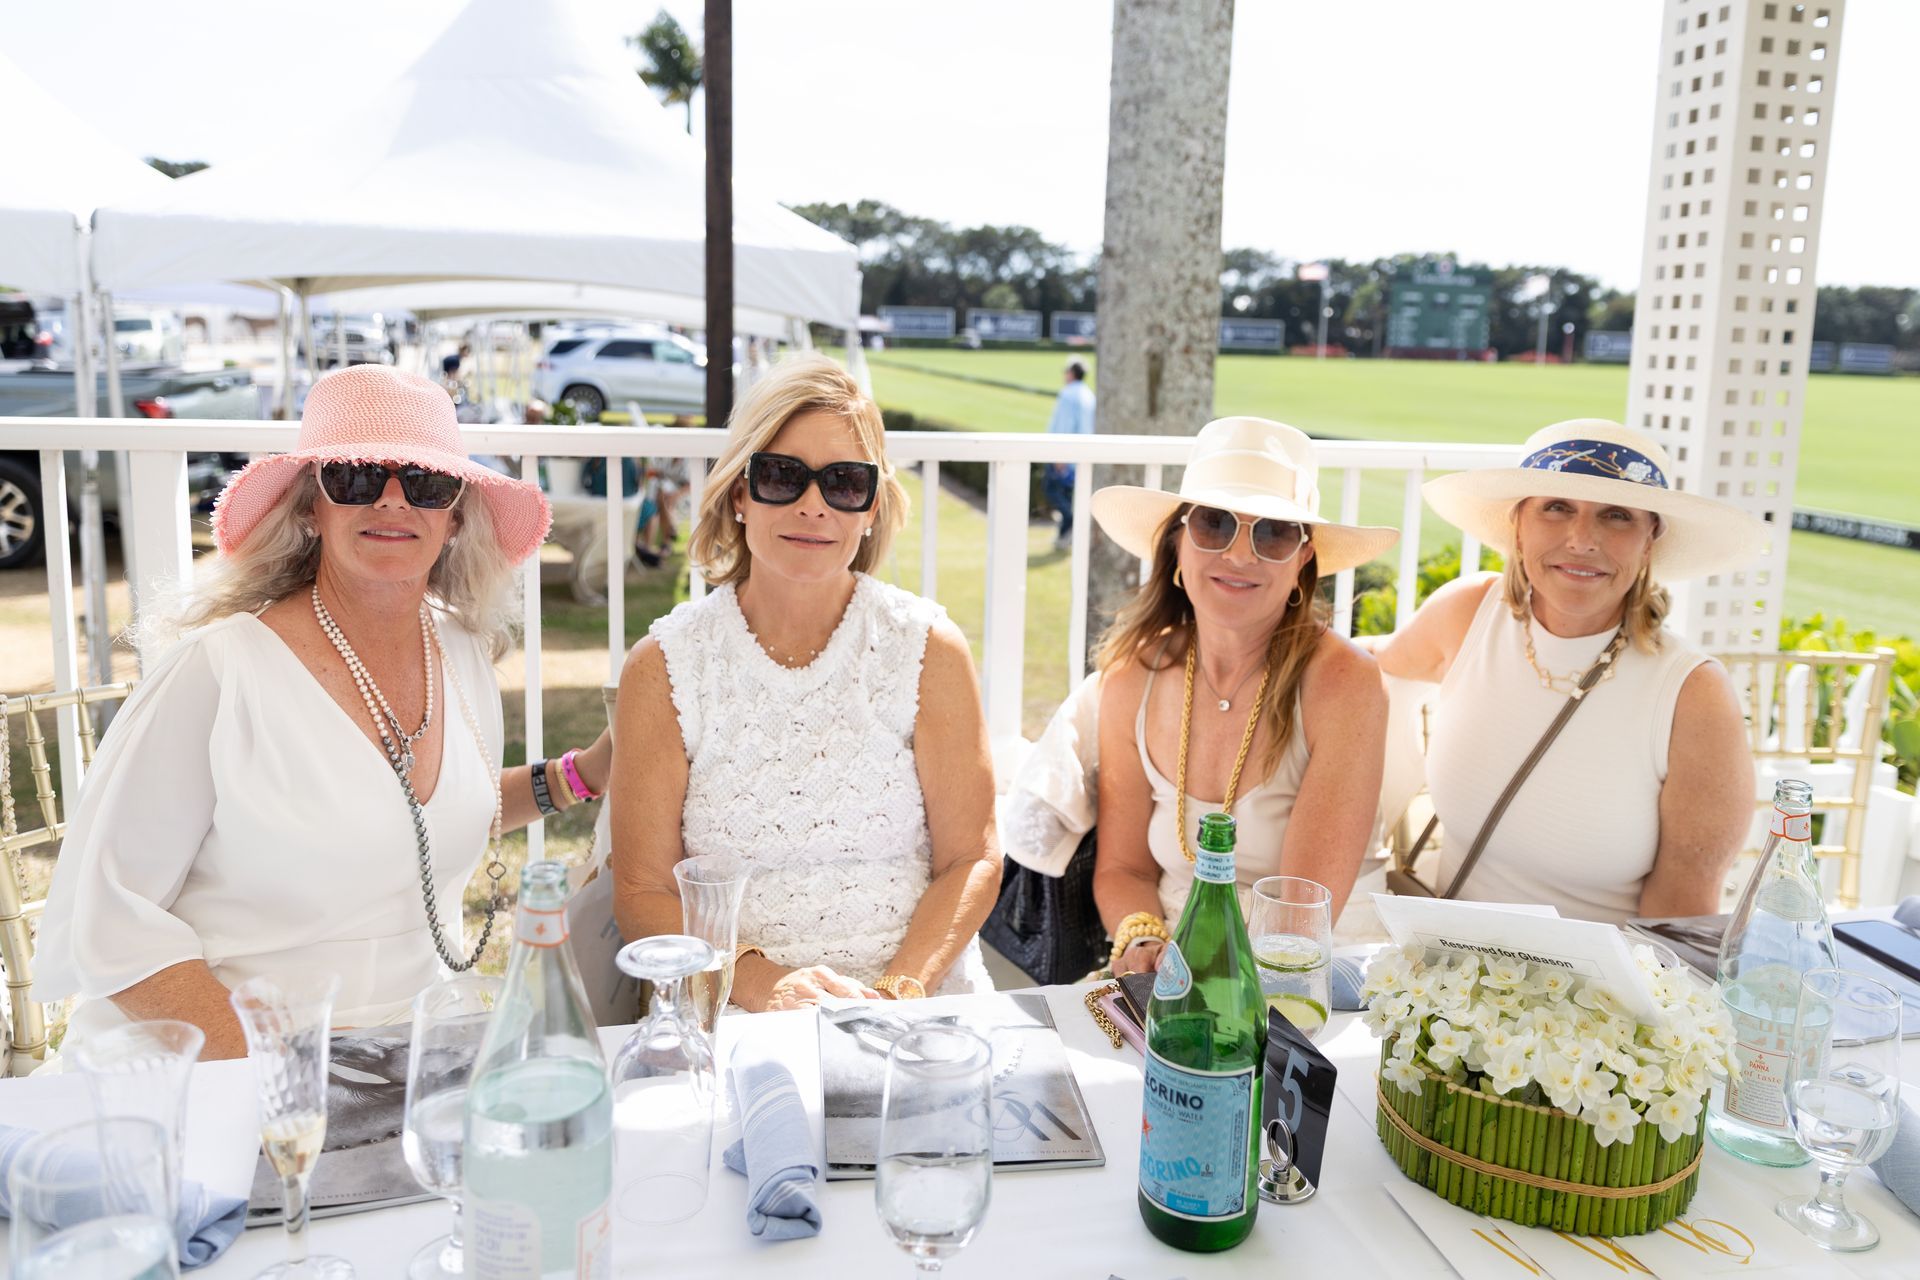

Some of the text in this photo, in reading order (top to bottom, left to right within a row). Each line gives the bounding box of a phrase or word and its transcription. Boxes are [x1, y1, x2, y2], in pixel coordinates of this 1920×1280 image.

[1440, 939, 1574, 969] Reserved for Gleason
[1278, 1047, 1309, 1135] 5
